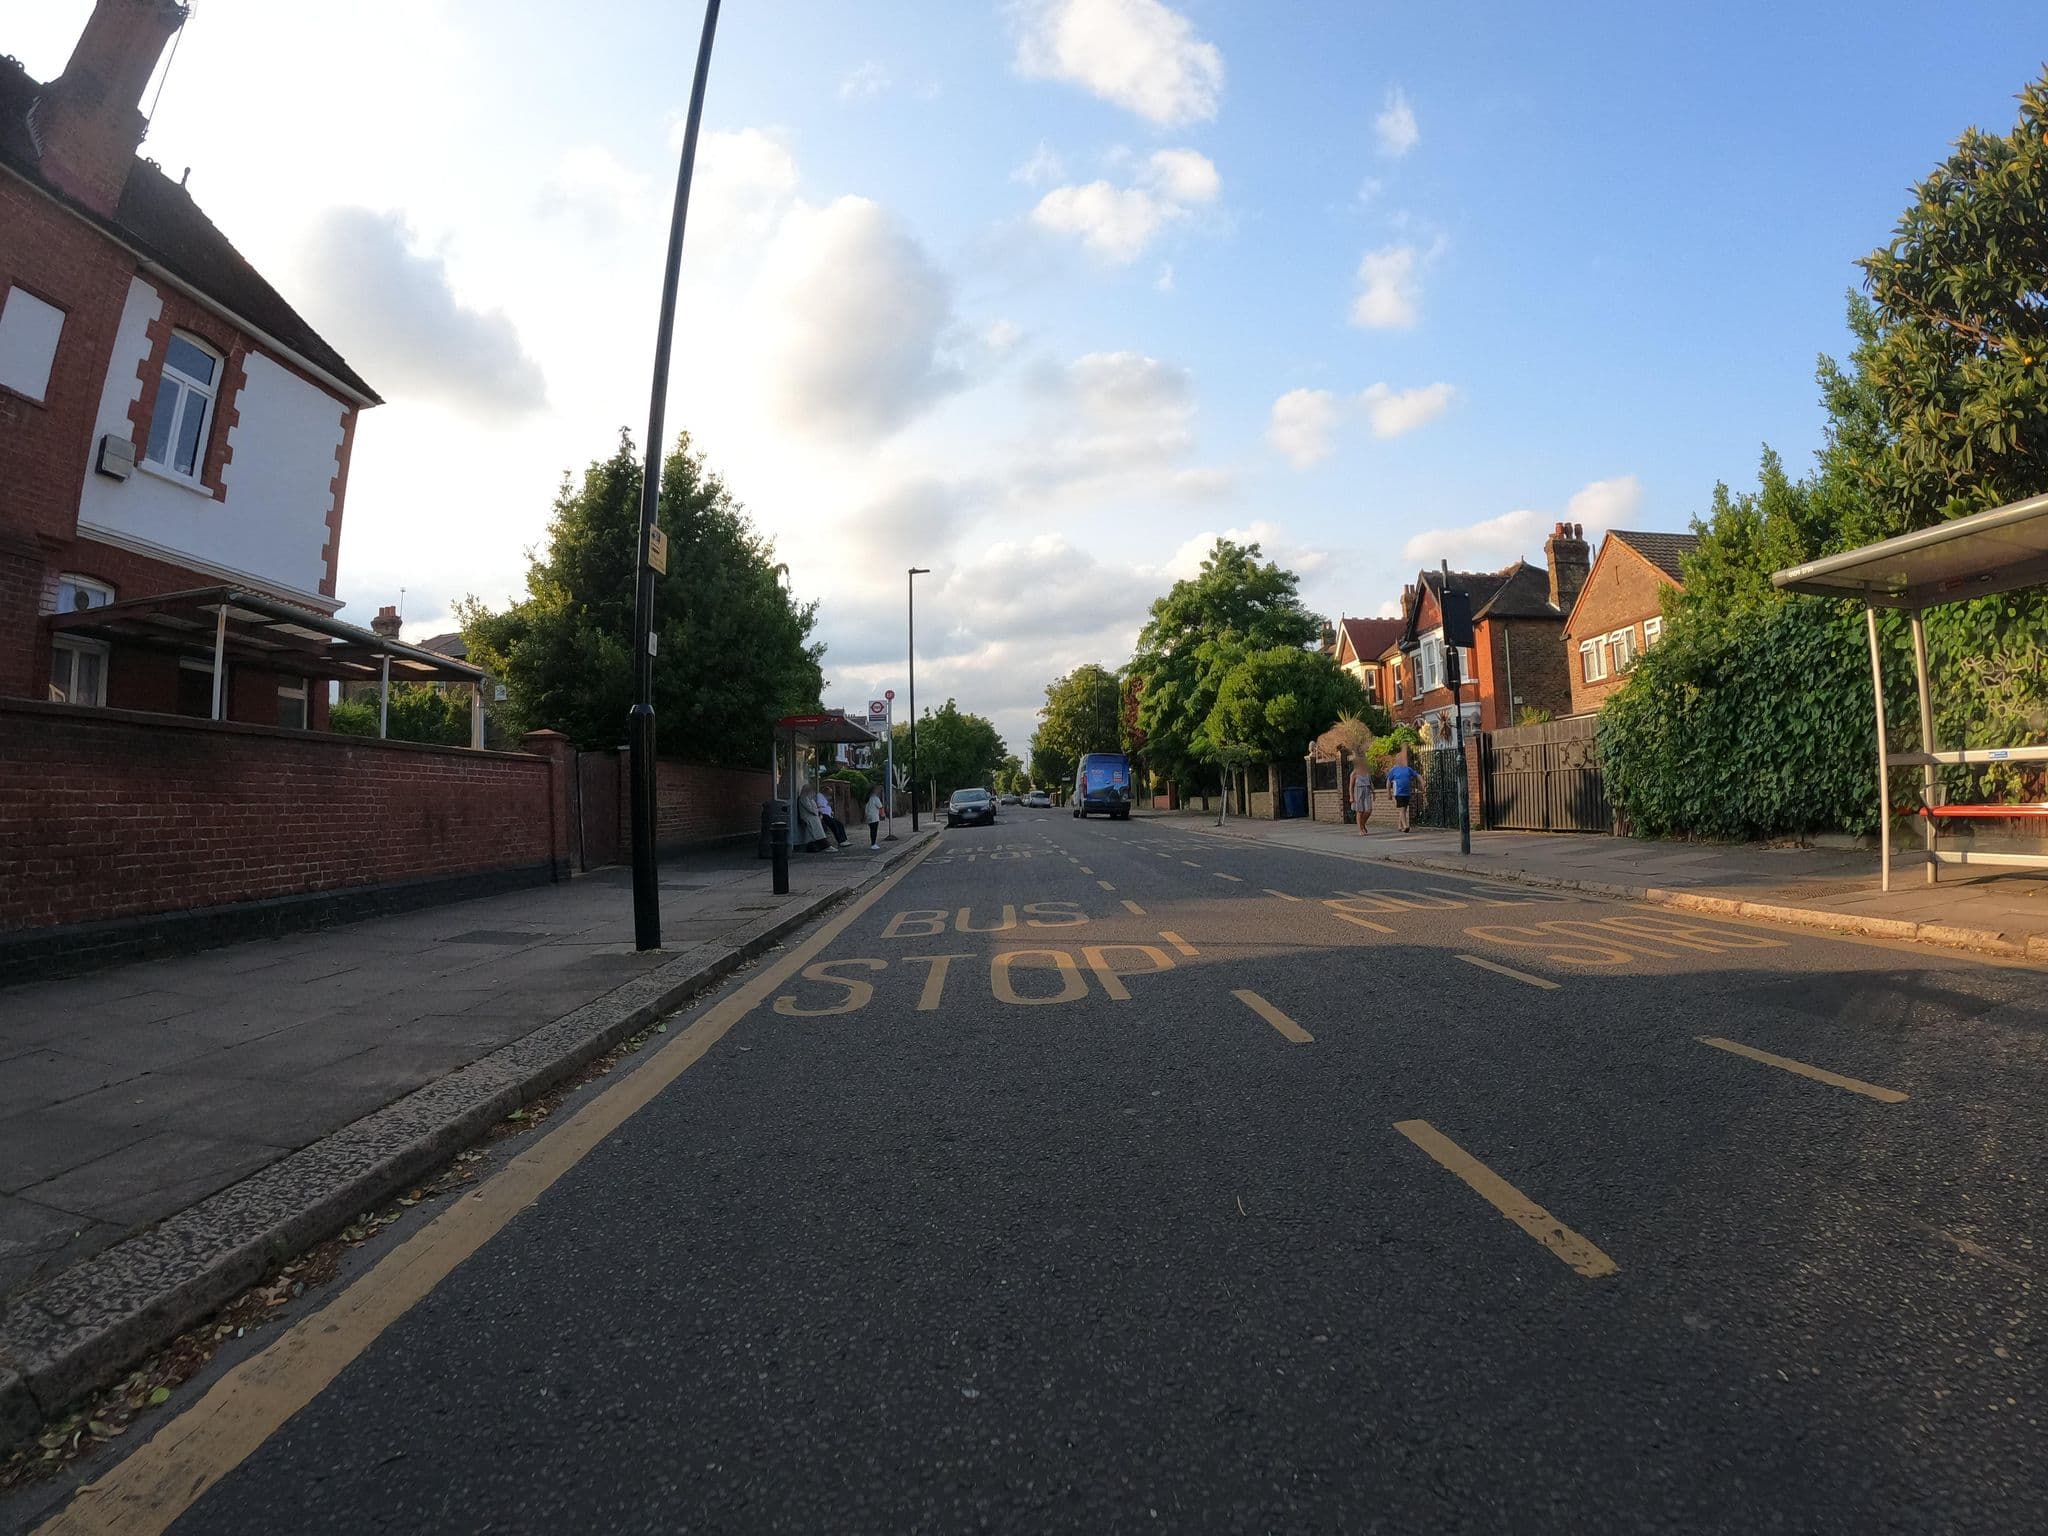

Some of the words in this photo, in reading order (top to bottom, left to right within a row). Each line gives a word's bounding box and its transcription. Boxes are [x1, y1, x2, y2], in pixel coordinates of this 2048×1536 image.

[880, 901, 1089, 938] BUS
[1319, 886, 1582, 913] STOP
[1463, 916, 1793, 965] BUS
[772, 945, 1176, 1017] STOP
